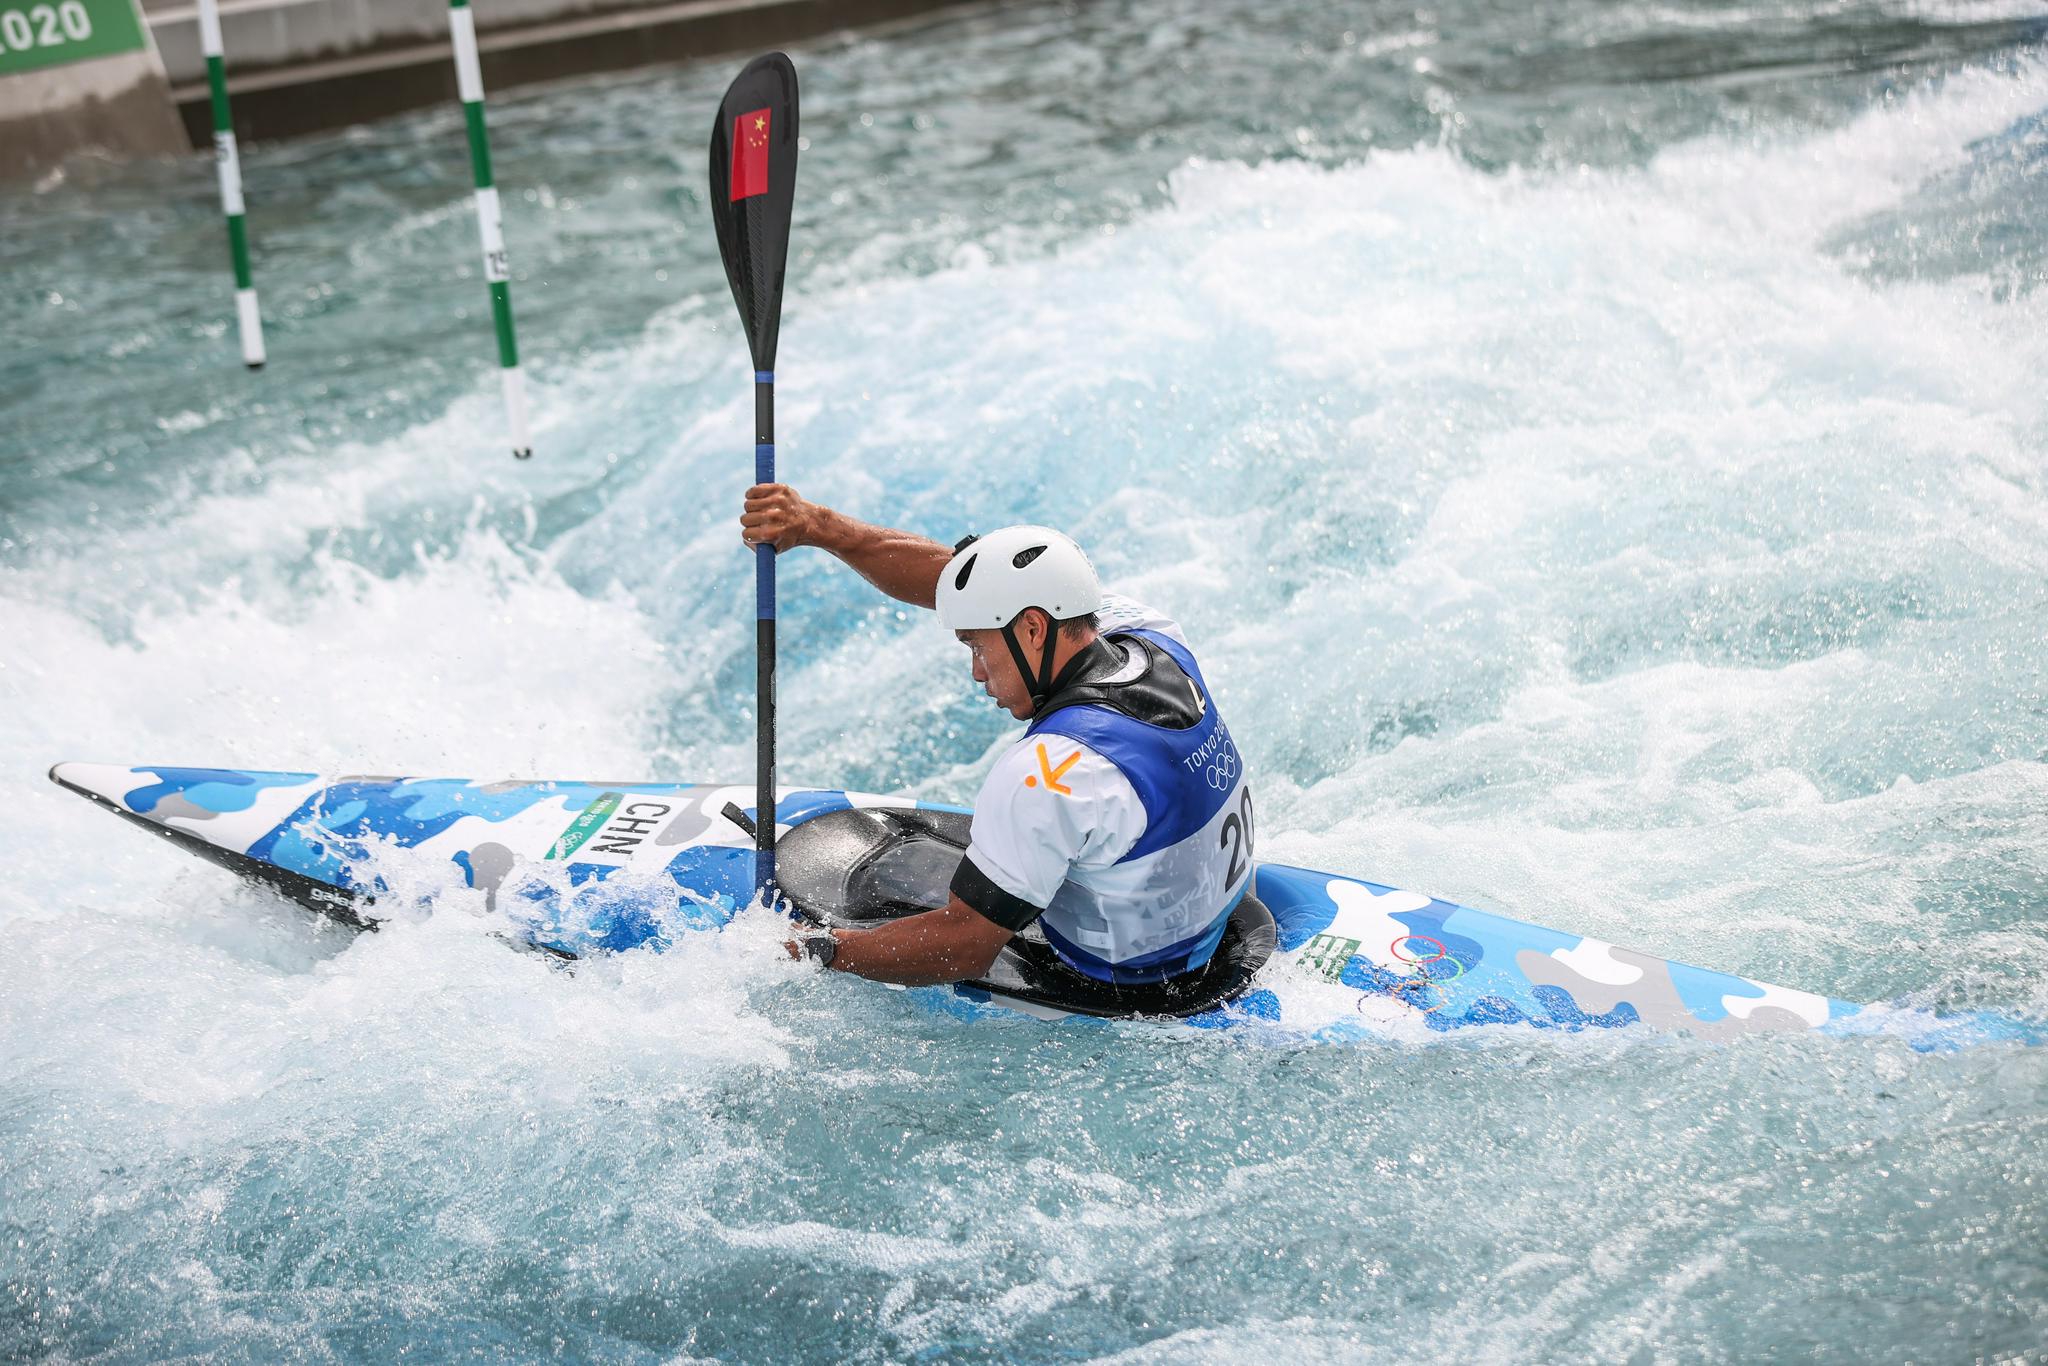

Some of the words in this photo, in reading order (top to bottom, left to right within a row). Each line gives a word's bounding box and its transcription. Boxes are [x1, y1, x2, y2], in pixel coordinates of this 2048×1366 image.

[0, 1, 92, 55] 020
[1184, 735, 1217, 773] TOKYO
[590, 803, 671, 855] CHN
[1221, 785, 1254, 893] 20
[309, 887, 352, 908] gala
